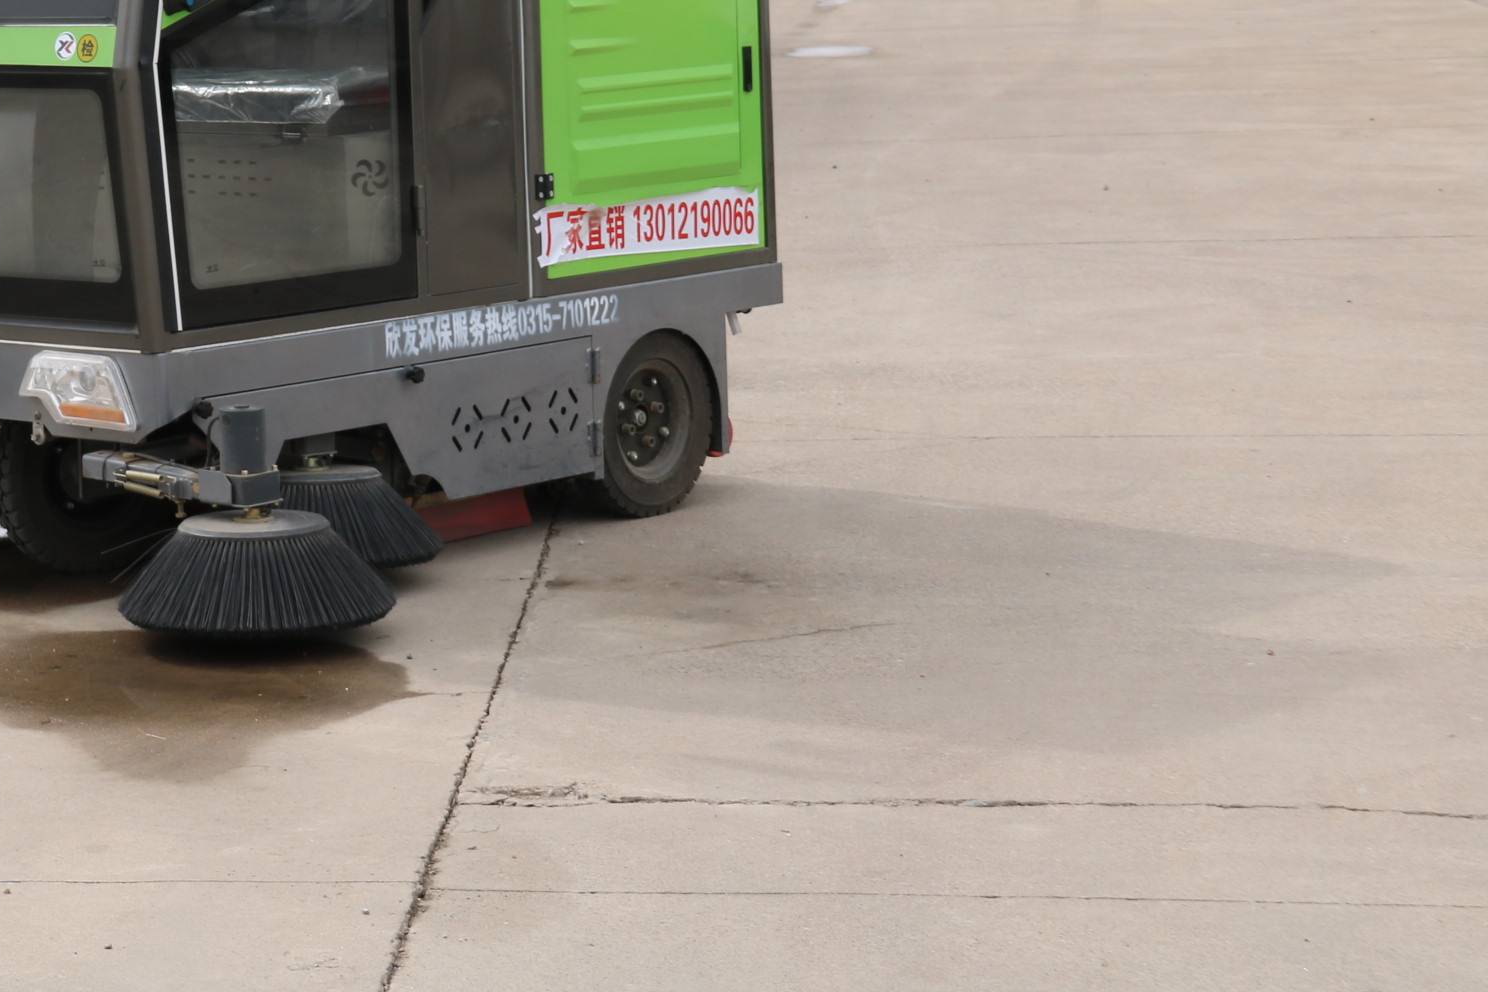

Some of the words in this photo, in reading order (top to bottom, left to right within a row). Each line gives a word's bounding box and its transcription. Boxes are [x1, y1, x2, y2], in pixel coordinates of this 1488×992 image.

[546, 205, 625, 256] 厂家直销
[633, 197, 755, 243] 13012190066
